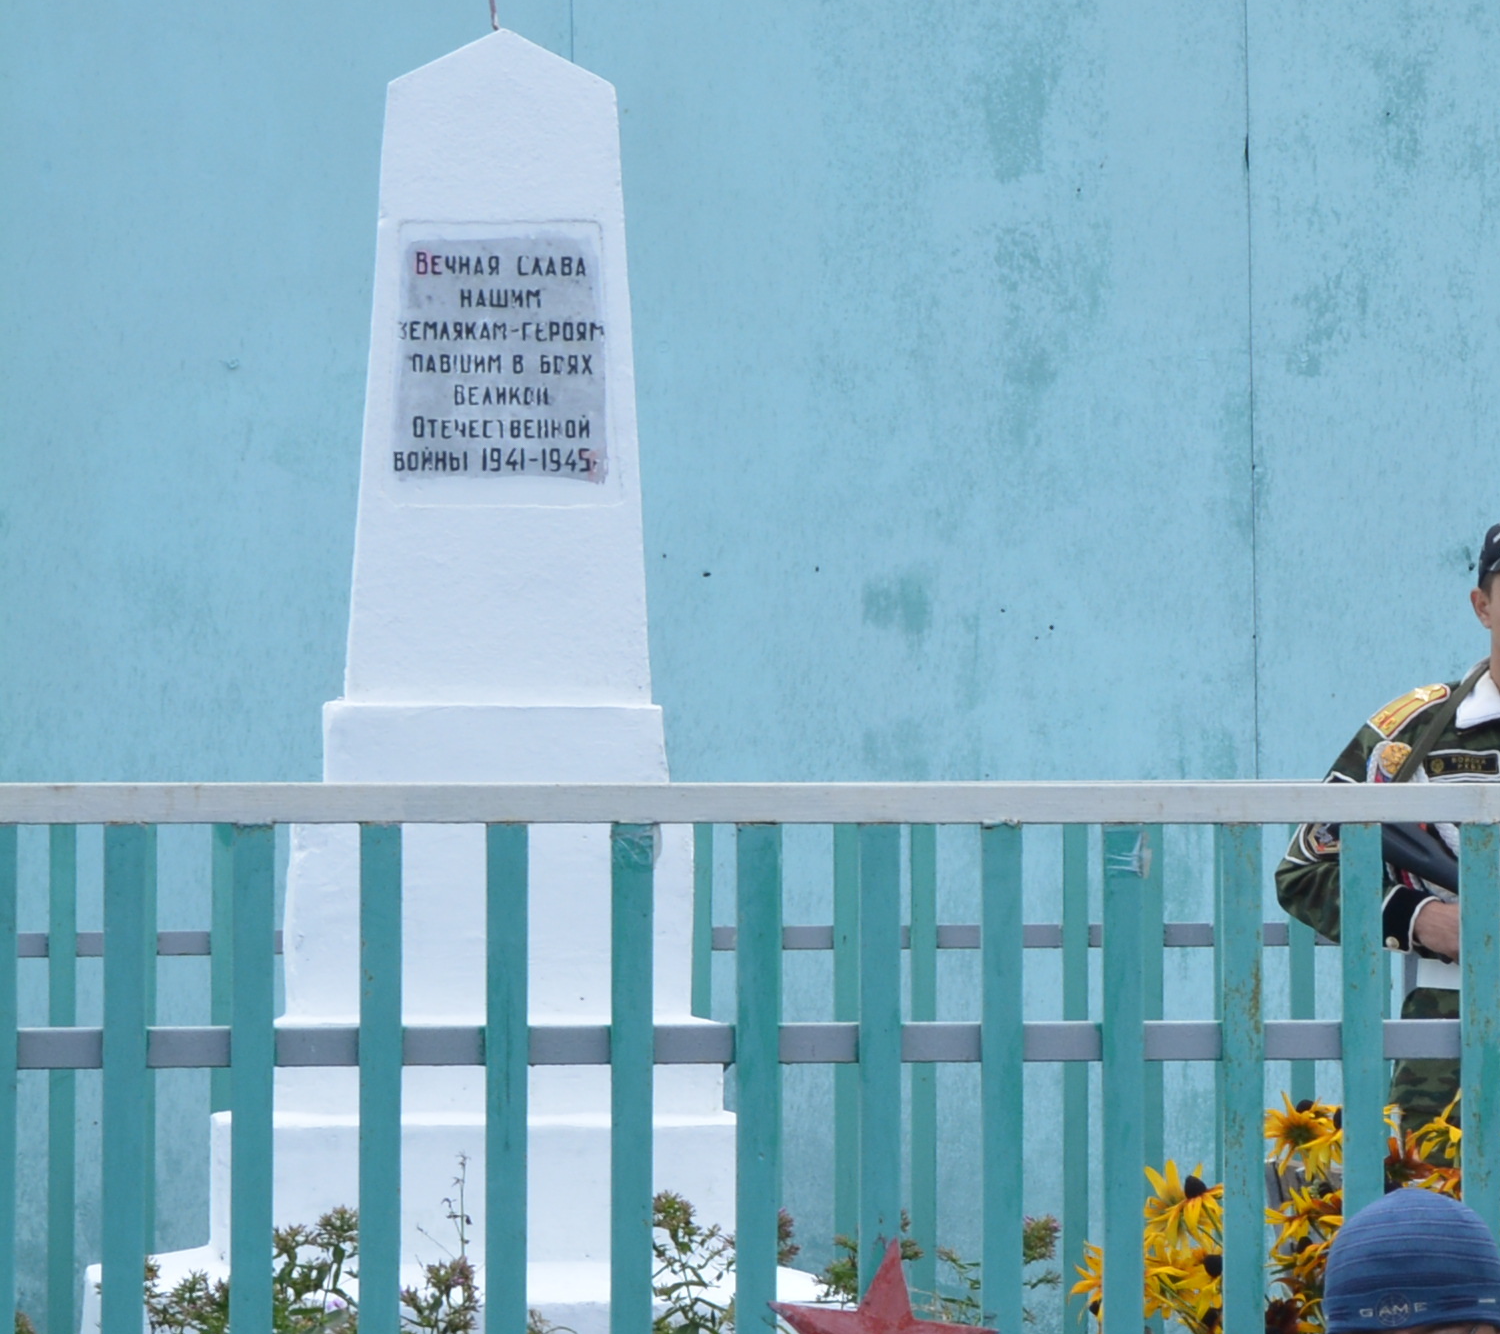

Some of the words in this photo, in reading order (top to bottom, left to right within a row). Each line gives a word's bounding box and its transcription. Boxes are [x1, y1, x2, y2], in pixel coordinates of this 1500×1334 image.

[517, 255, 587, 277] СЛАВА
[460, 289, 542, 309] НАШИМ
[412, 354, 502, 374] ПАВШИМ
[513, 354, 524, 374] В
[1359, 1301, 1428, 1318] GAME
